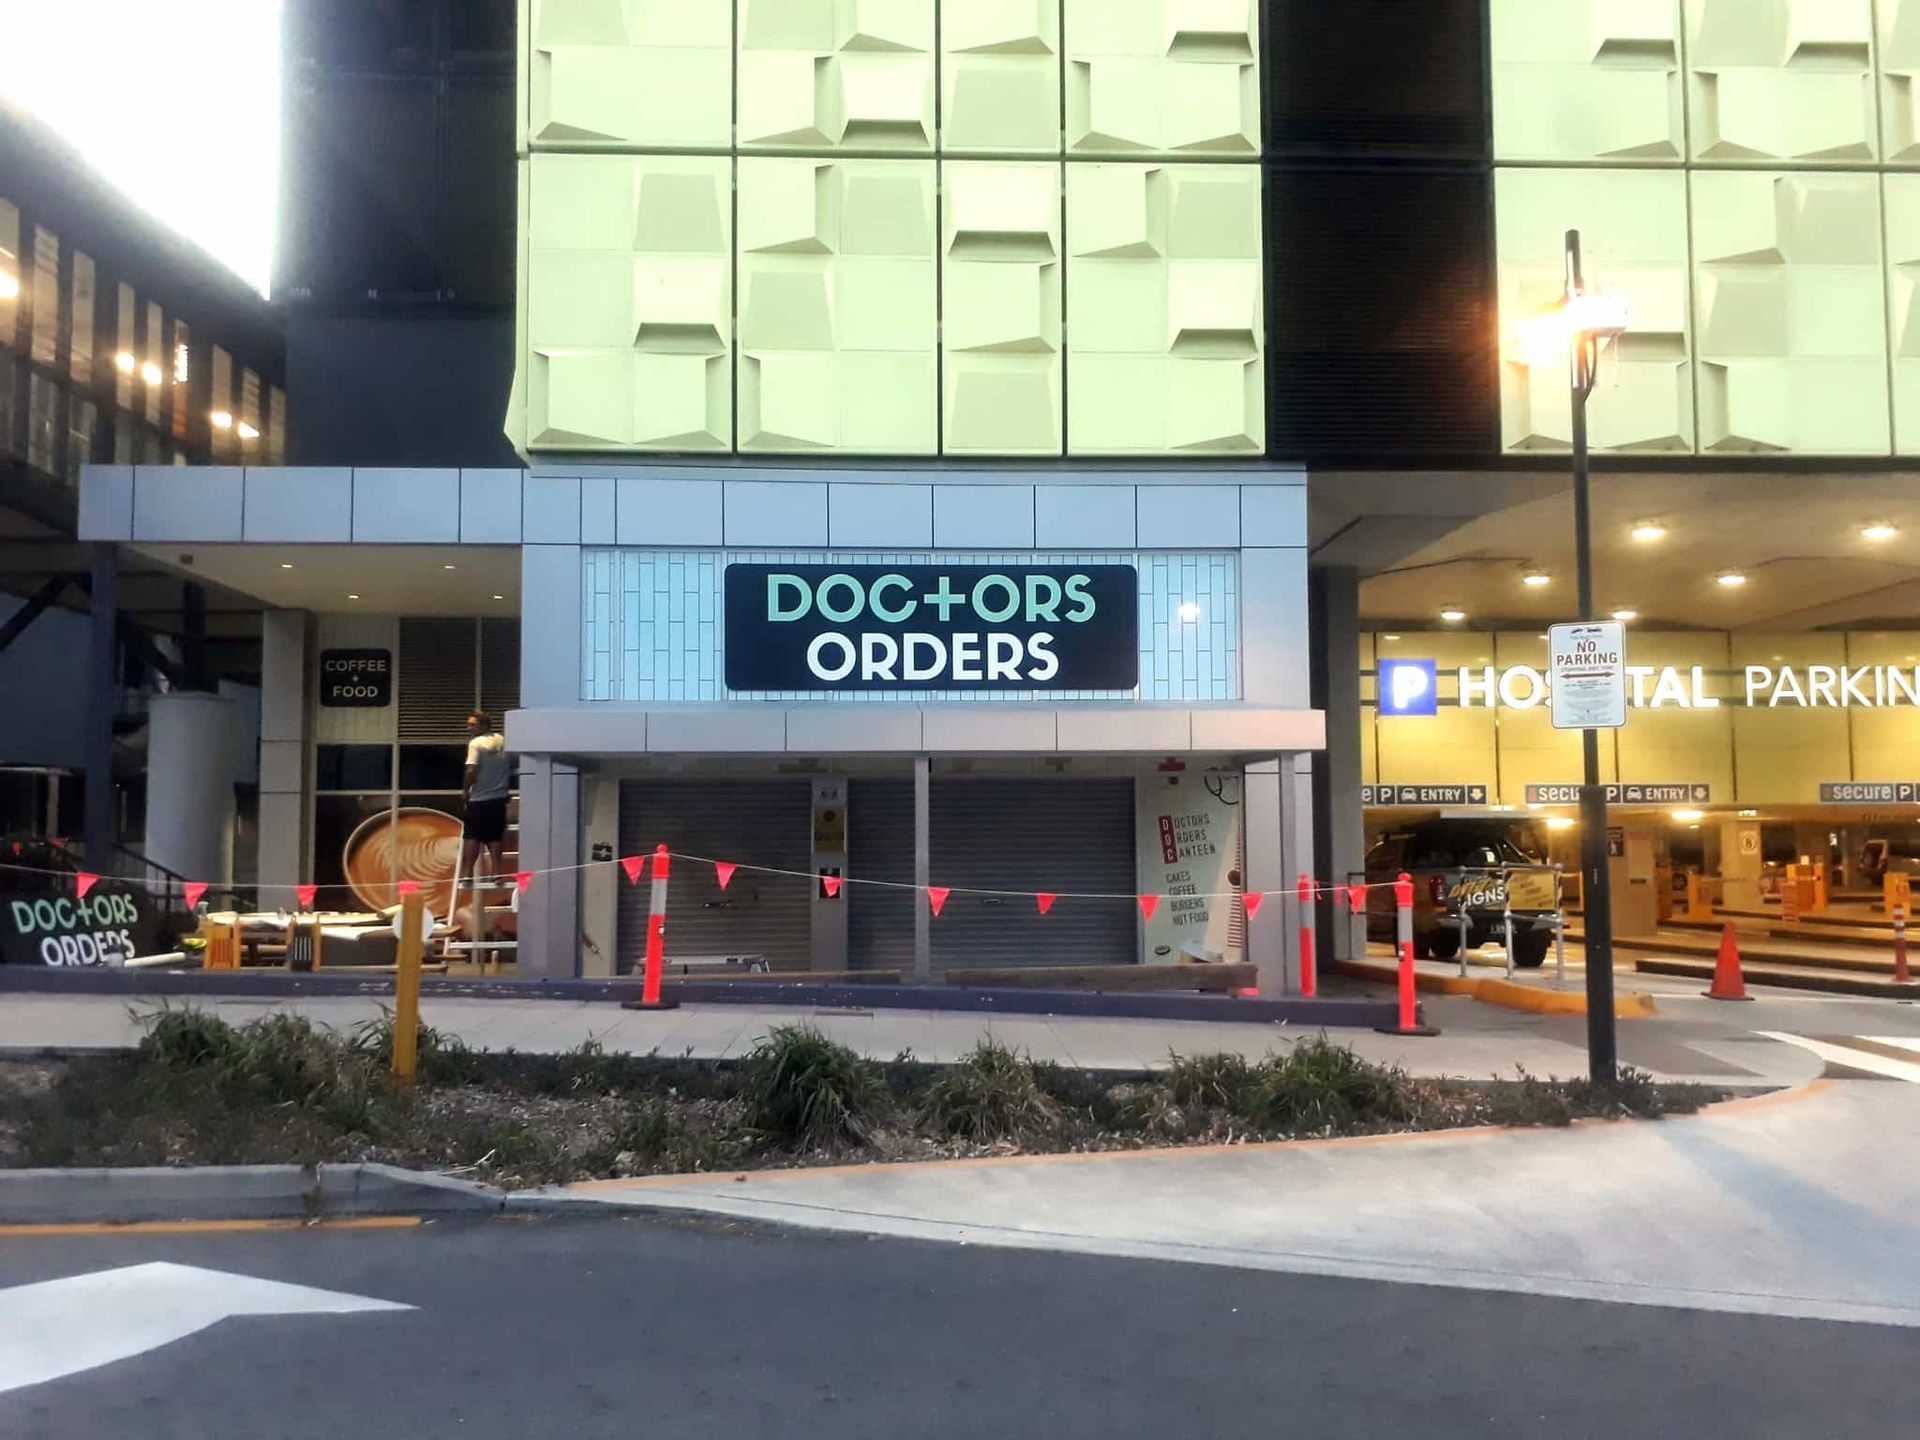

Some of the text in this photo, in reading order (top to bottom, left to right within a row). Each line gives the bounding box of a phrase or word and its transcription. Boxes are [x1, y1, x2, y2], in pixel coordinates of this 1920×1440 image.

[1577, 641, 1596, 653] NO
[807, 632, 1059, 681] ORDERS
[1557, 652, 1618, 666] PARKING
[326, 660, 386, 672] COFFEE
[333, 685, 378, 697] FOOD
[1393, 666, 1428, 709] P
[1459, 665, 1719, 709] HOTAL
[1380, 788, 1391, 801] P
[1421, 788, 1461, 801] ENTRY
[1538, 787, 1685, 801] secu P ENTRY
[1833, 785, 1911, 800] secure P
[1166, 871, 1191, 883] CAKES
[1168, 884, 1196, 896] COFFEE
